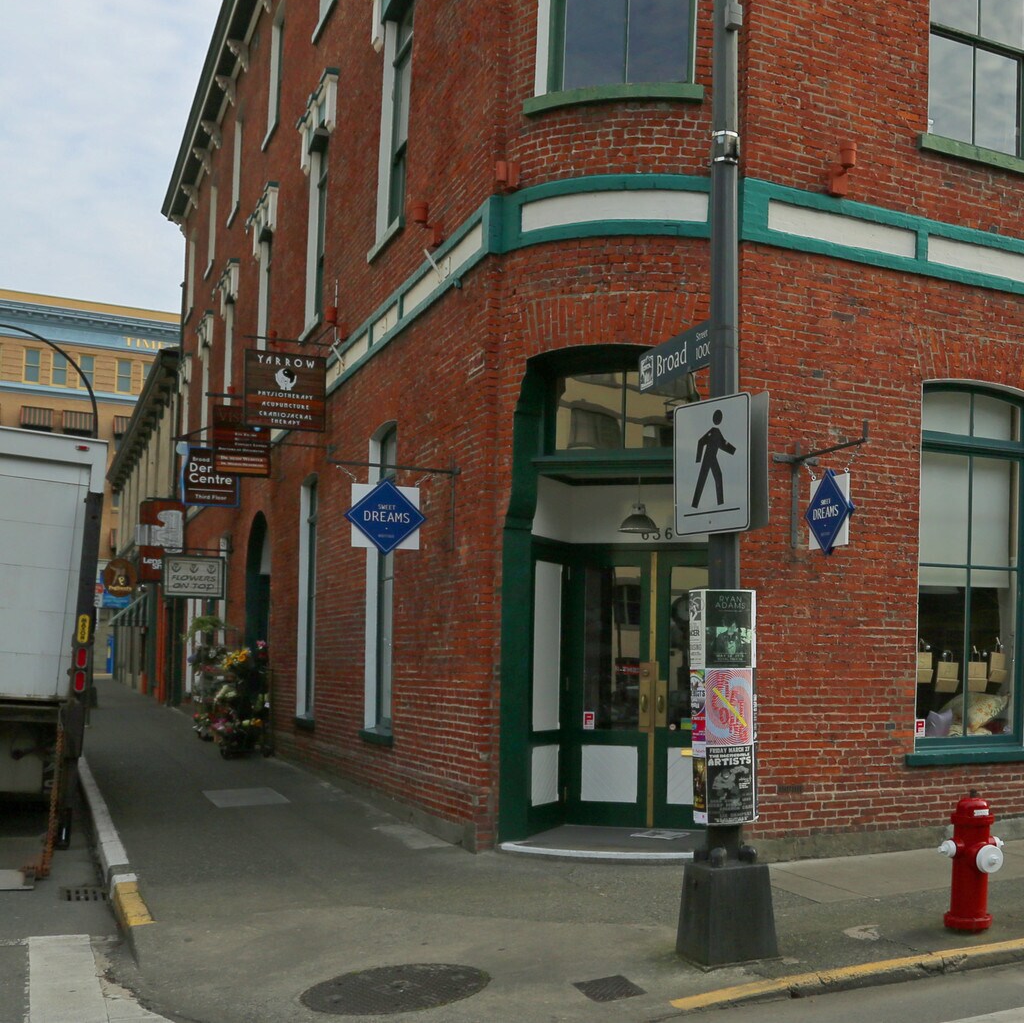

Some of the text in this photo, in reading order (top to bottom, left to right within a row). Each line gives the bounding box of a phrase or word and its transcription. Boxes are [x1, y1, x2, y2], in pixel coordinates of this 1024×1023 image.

[257, 354, 315, 369] YARROW
[656, 341, 687, 377] Broad
[257, 390, 314, 400] PHYSIOTHERAPY
[261, 401, 310, 411] ACUPUNCTURE
[258, 410, 312, 420] CRANIOSACRAL
[271, 418, 301, 426] THERAPY
[189, 473, 232, 485] Centre
[363, 510, 410, 524] DREAMS
[812, 505, 839, 521] DREAMS
[192, 583, 214, 591] TOP
[715, 602, 746, 610] ADAMS
[708, 756, 751, 766] ARTISTS
